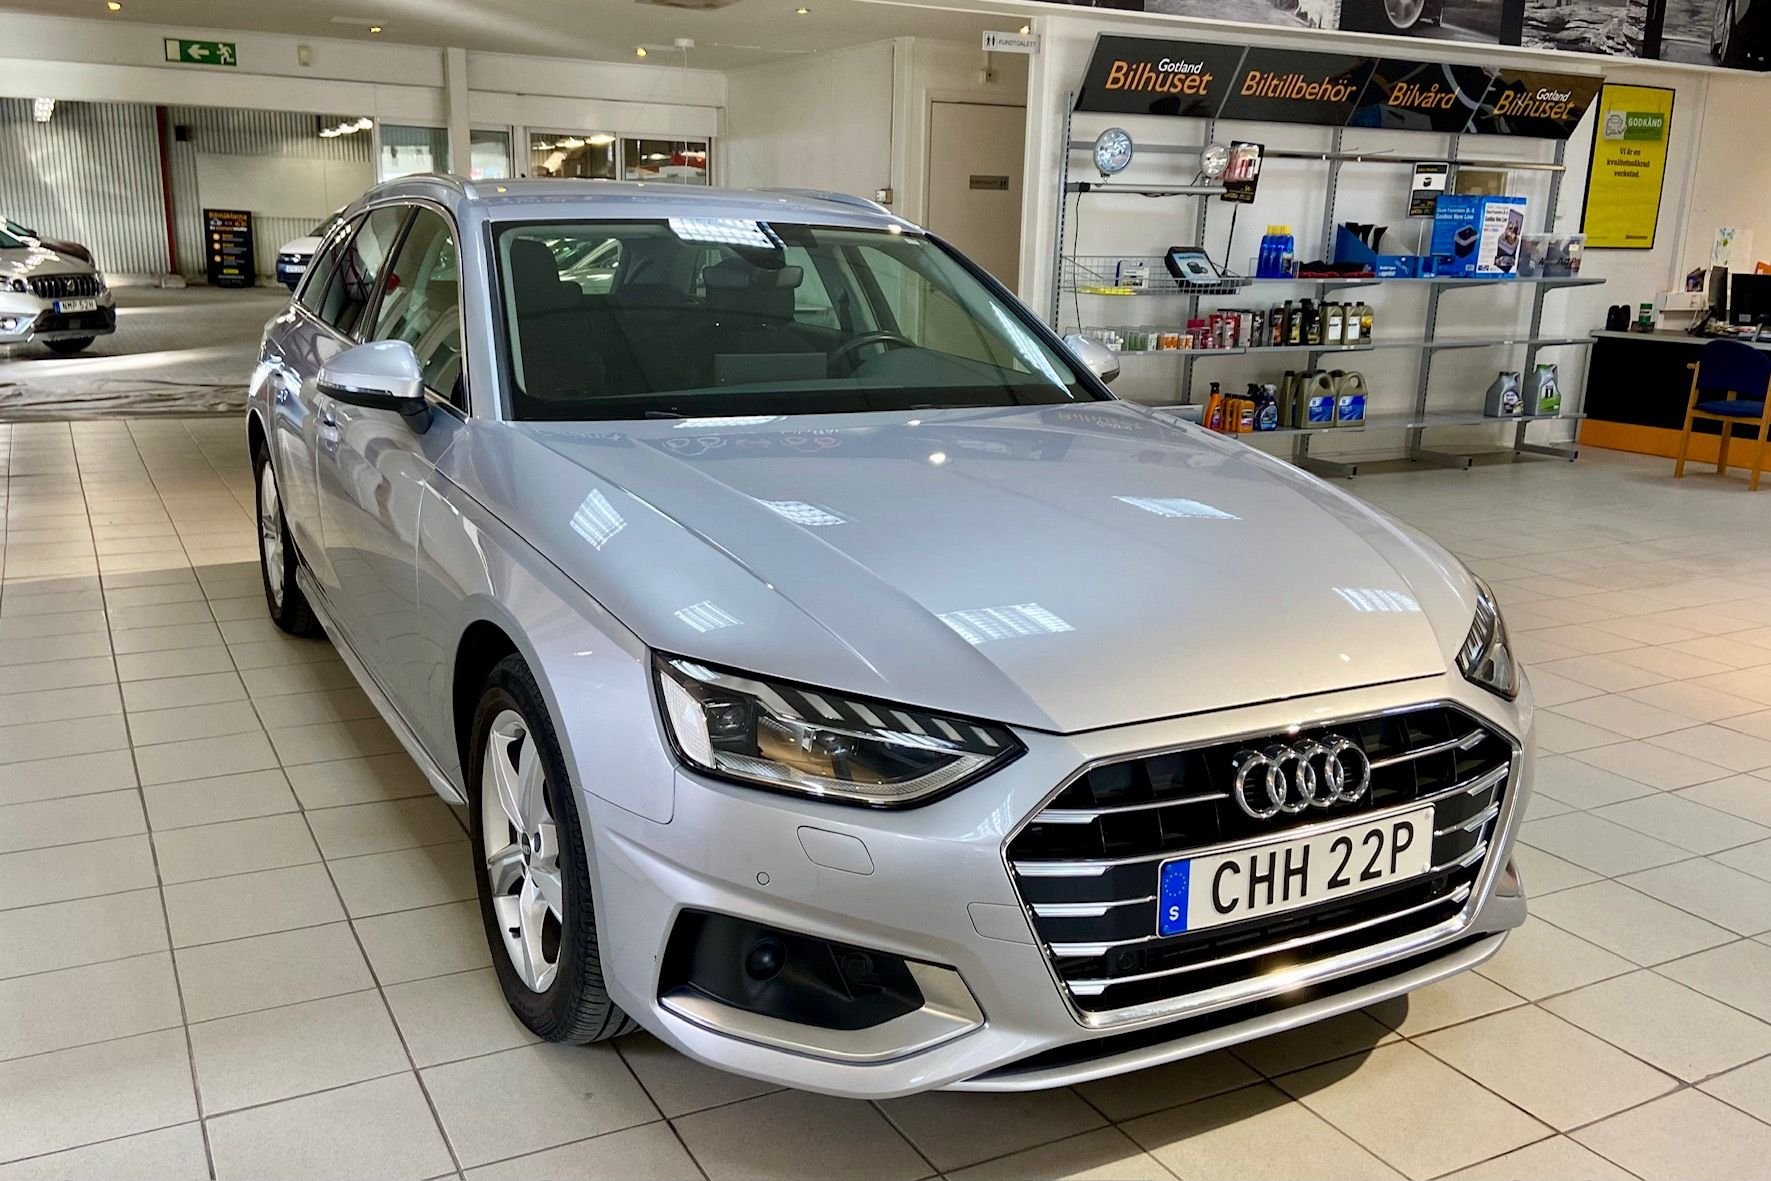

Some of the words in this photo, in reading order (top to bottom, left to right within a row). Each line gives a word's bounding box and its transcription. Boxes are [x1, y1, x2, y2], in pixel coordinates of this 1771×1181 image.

[998, 39, 1036, 48] KUNDTOALETT
[1105, 60, 1214, 96] Bilhuset
[1158, 57, 1205, 74] Gotland
[1240, 70, 1357, 102] Biltillbehör
[1388, 82, 1460, 109] Bilvård
[1536, 88, 1572, 103] Gotland
[1493, 90, 1576, 120] Bilhuset
[1212, 844, 1311, 914] CHH
[1327, 820, 1414, 890] 22P
[1169, 905, 1180, 921] S
